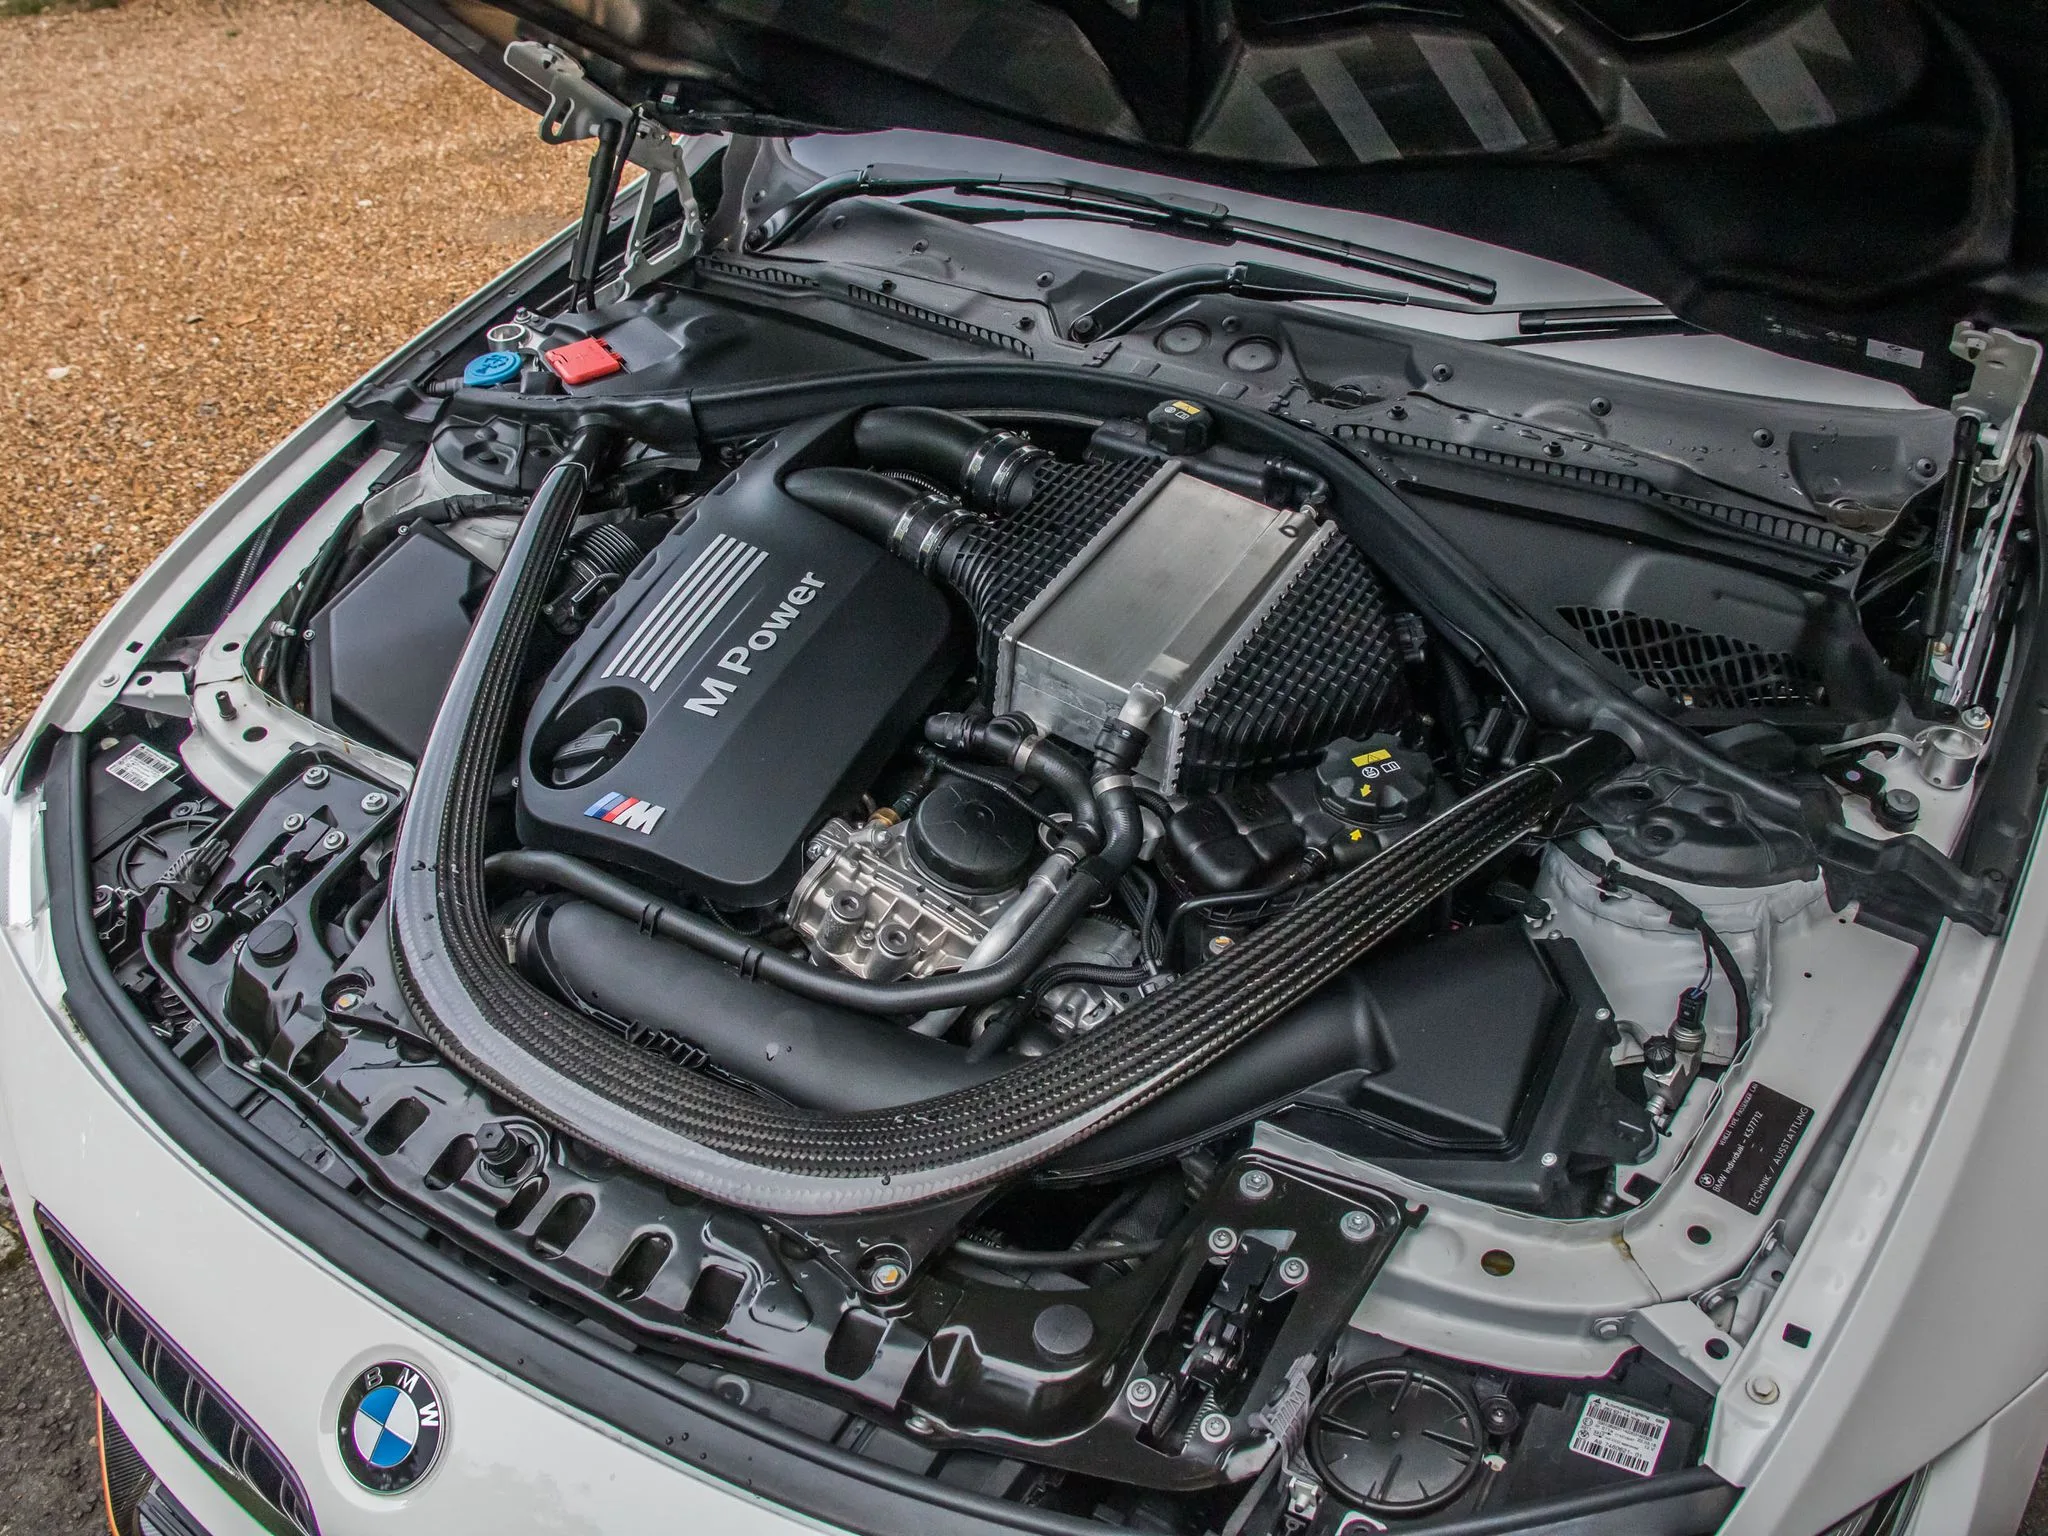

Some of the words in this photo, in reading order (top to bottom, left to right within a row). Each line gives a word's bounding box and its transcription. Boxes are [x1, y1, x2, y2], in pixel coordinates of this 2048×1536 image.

[683, 676, 738, 718] M
[717, 571, 826, 676] Power
[611, 799, 667, 836] M
[1712, 1173, 1728, 1193] BMW
[1723, 1143, 1746, 1175] Individual
[1747, 1174, 1772, 1208] TECHNIK
[1772, 1106, 1809, 1166] AUSSTATTUNG
[364, 1365, 440, 1427] BMW
